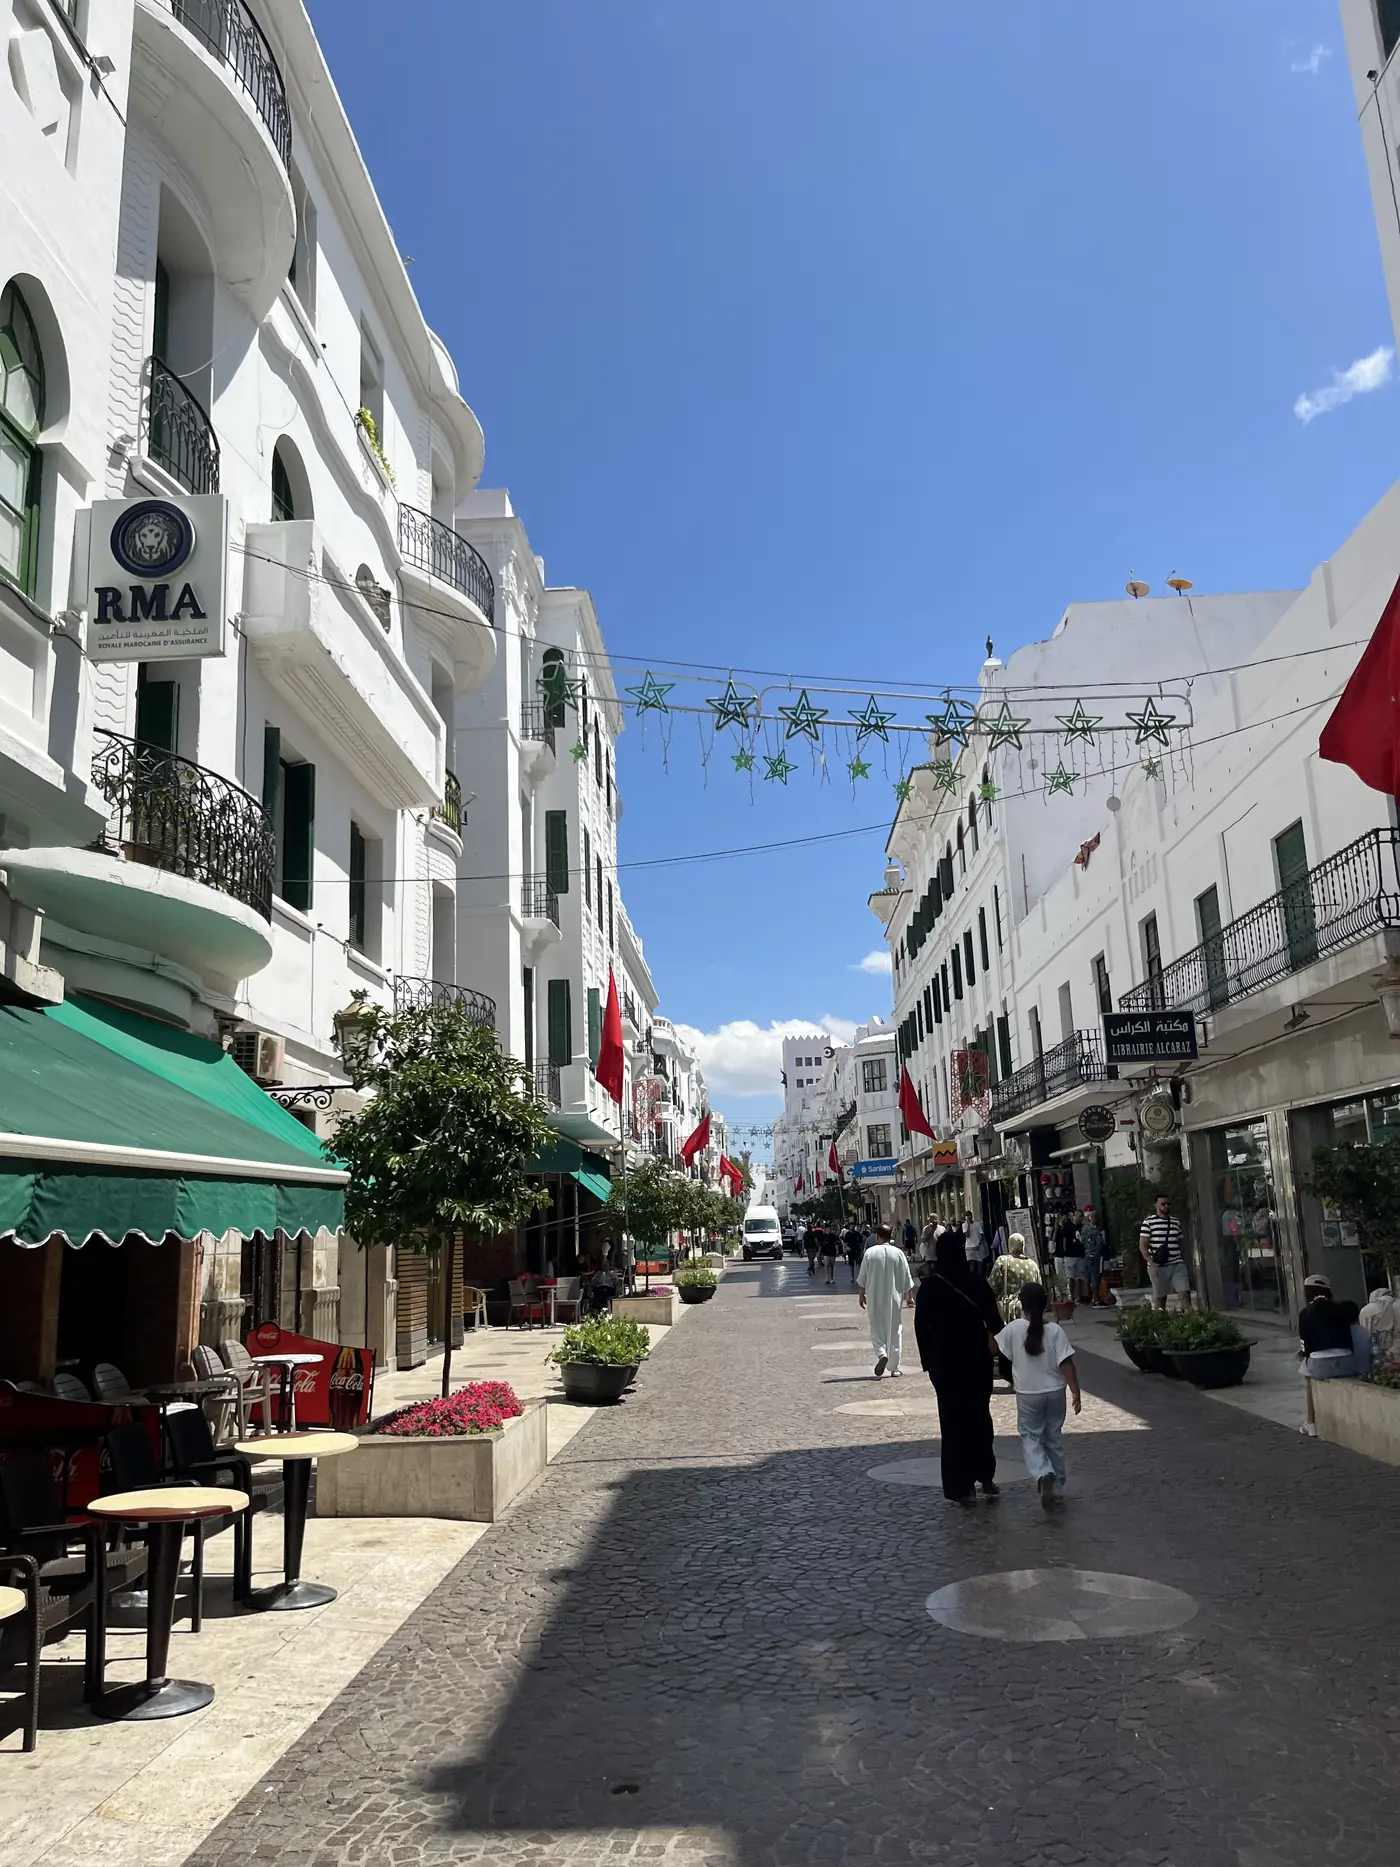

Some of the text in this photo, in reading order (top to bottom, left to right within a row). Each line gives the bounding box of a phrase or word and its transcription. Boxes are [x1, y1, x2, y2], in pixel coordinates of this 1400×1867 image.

[93, 582, 207, 625] RMA
[98, 627, 209, 641] الملكية المغربية للتأمين
[123, 640, 161, 648] MAROCAINE
[163, 638, 208, 646] D'ASSURANCE
[1156, 1019, 1188, 1034] مكتبة
[1112, 1041, 1191, 1056] LIBRAIRIE ALCARAZ
[868, 1165, 892, 1173] Sanlam
